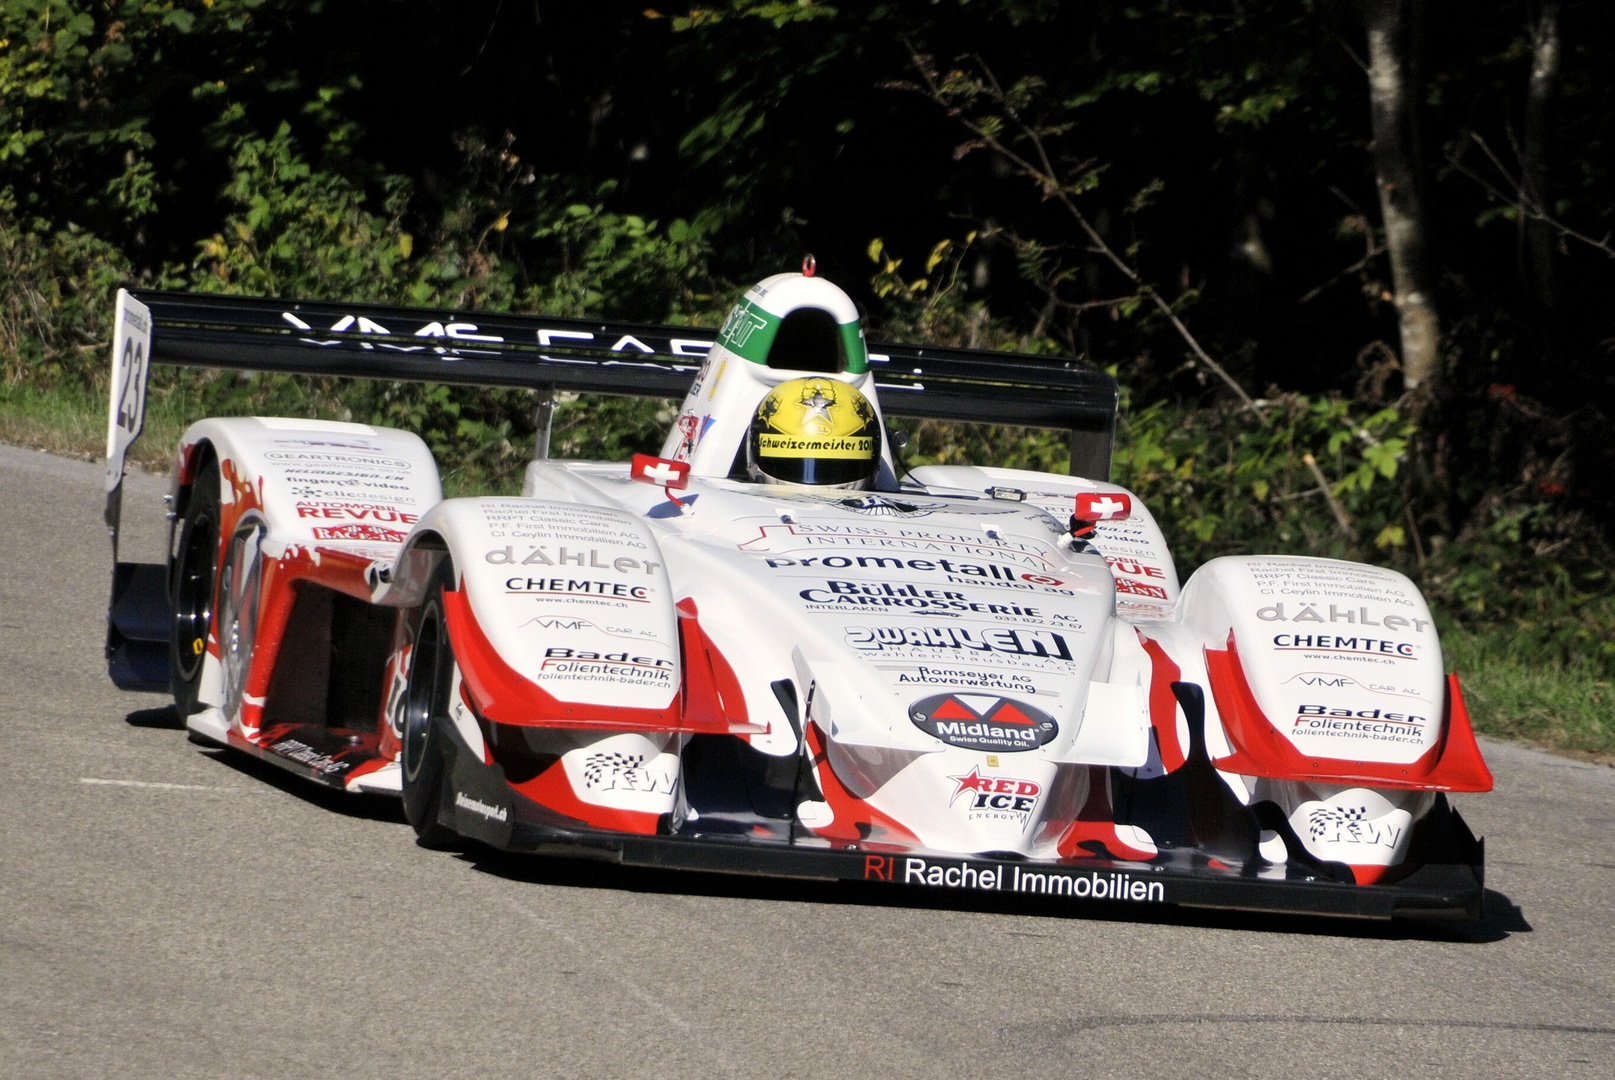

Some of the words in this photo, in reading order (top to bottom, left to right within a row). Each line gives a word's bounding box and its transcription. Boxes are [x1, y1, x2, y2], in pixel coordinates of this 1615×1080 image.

[117, 336, 142, 434] 23
[270, 452, 405, 468] GEARTRONICS
[363, 481, 410, 491] video
[296, 500, 401, 513] AUTOMOBIL
[296, 507, 419, 525] REVUE
[549, 504, 618, 517] Immobilien
[529, 515, 577, 525] Classic
[579, 517, 610, 529] Cars
[564, 511, 633, 525] Immobilien
[489, 522, 513, 530] P.F.
[516, 522, 545, 530] First
[548, 523, 618, 538] Immobilien
[620, 530, 641, 541] AG
[511, 530, 552, 541] Ceylin
[555, 532, 625, 546] Immobilien
[627, 540, 648, 550] AG
[799, 523, 889, 536] SWISS
[899, 529, 1049, 558] PROPERTY
[1103, 533, 1150, 545] video
[805, 536, 1058, 573] INTERNATIONAL
[765, 555, 1018, 582] prometall
[1315, 563, 1383, 576] Immobilien
[1329, 569, 1398, 583] Immobilien
[505, 577, 649, 599] CHEMTEC
[946, 574, 1035, 592] handel
[1043, 585, 1076, 597] ag
[1257, 580, 1280, 588] P.F.
[1283, 580, 1311, 588] First
[1314, 581, 1384, 596] Immobilien
[1385, 588, 1406, 598] AG
[1296, 573, 1343, 582] Classic
[1345, 576, 1376, 586] Cars
[536, 596, 629, 609] www.chemtec.ch
[1280, 588, 1321, 599] Ceylin
[1324, 589, 1392, 603] Immobilien
[1394, 598, 1415, 607] AG
[806, 604, 889, 613] INTERLAKEN
[1052, 613, 1079, 622] AG
[536, 619, 593, 630] VMF
[606, 626, 633, 635] CAR
[639, 630, 658, 638] AG
[1273, 633, 1415, 657] CHEMTEC
[544, 647, 675, 667] Bader
[890, 646, 1022, 660] HAUSBAU
[1045, 657, 1077, 668] AG
[1303, 653, 1396, 666] www.chemtec.ch
[540, 659, 672, 681] Folientechnik
[918, 666, 1005, 683] Ramseyer
[1011, 674, 1032, 683] AG
[537, 672, 672, 689] folientechnik-bader.ch
[899, 673, 1036, 693] Autoverwertung
[1298, 677, 1355, 688] VMF
[1369, 683, 1396, 692] CAR
[1402, 688, 1421, 696] AG
[1296, 704, 1427, 724] Bader
[936, 721, 1036, 742] Midland
[1294, 715, 1424, 738] Folientechnik
[949, 735, 978, 744] Swiss
[979, 737, 1013, 748] Quality
[1291, 728, 1424, 746] folientechnik-bader.ch
[601, 767, 679, 796] KW
[976, 778, 1039, 796] RED
[974, 793, 1035, 813] ICE
[968, 812, 1015, 821] ENERGY
[1324, 819, 1402, 850] KW
[864, 855, 894, 881] RI
[905, 857, 1003, 891] Rachel
[1013, 866, 1165, 902] Immobilien
